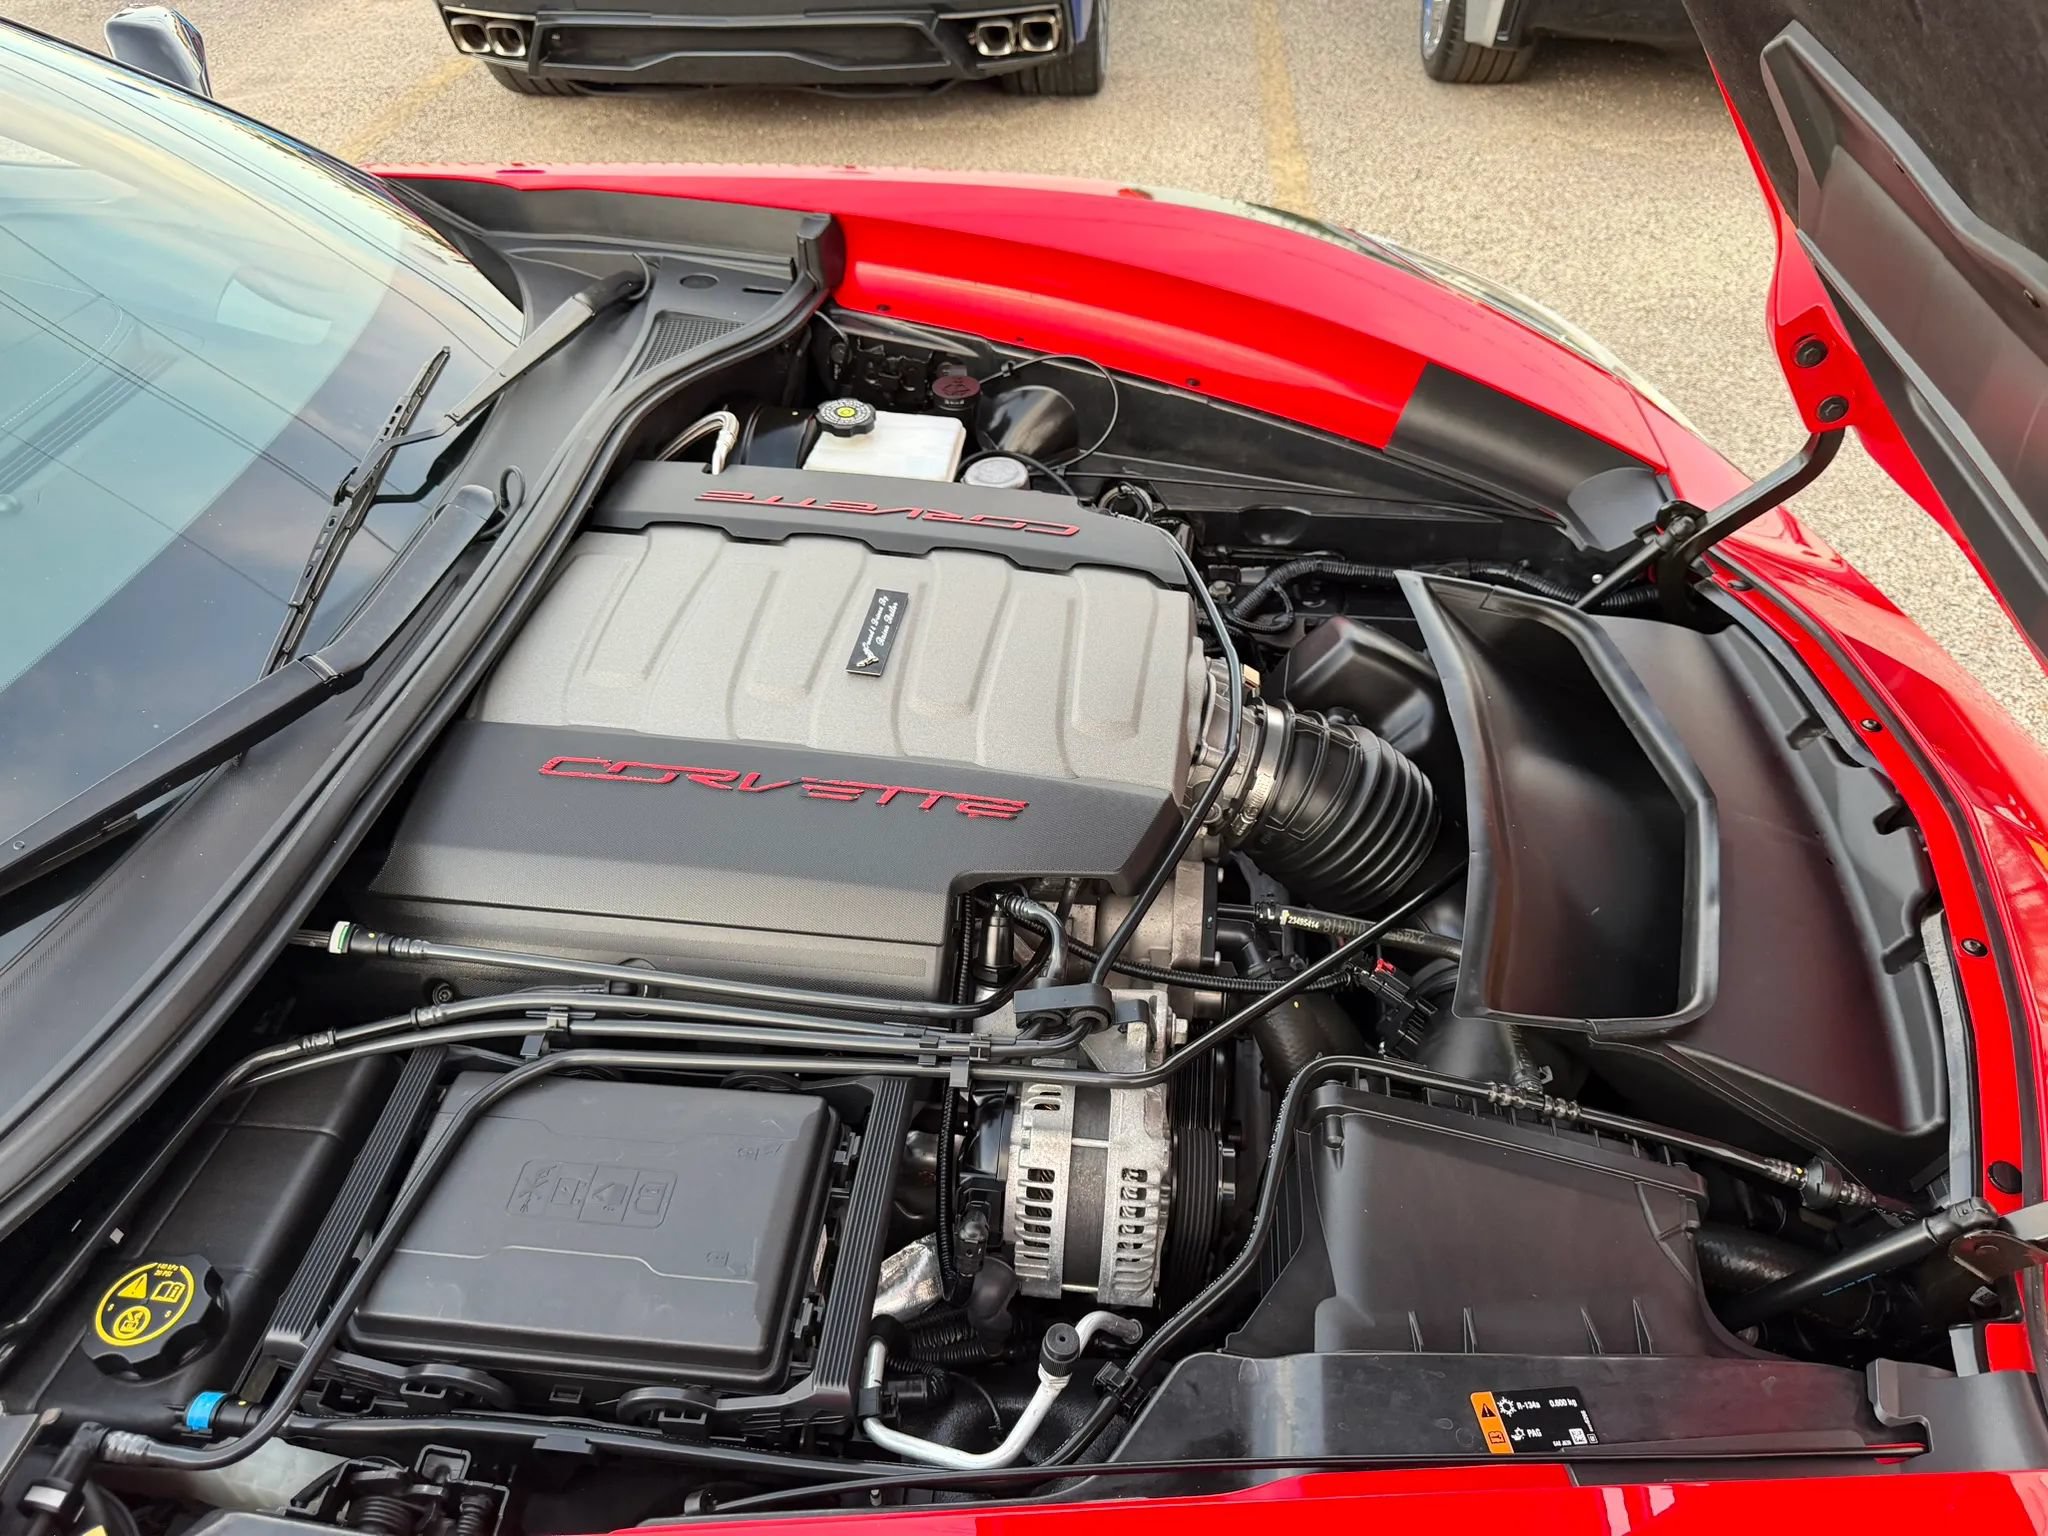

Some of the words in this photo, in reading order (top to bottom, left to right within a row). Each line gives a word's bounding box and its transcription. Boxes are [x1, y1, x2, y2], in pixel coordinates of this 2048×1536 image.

[694, 490, 1080, 538] CORVETTE
[878, 595, 889, 606] By
[540, 757, 1027, 821] CORVETTE
[1526, 1428, 1542, 1438] PAG
